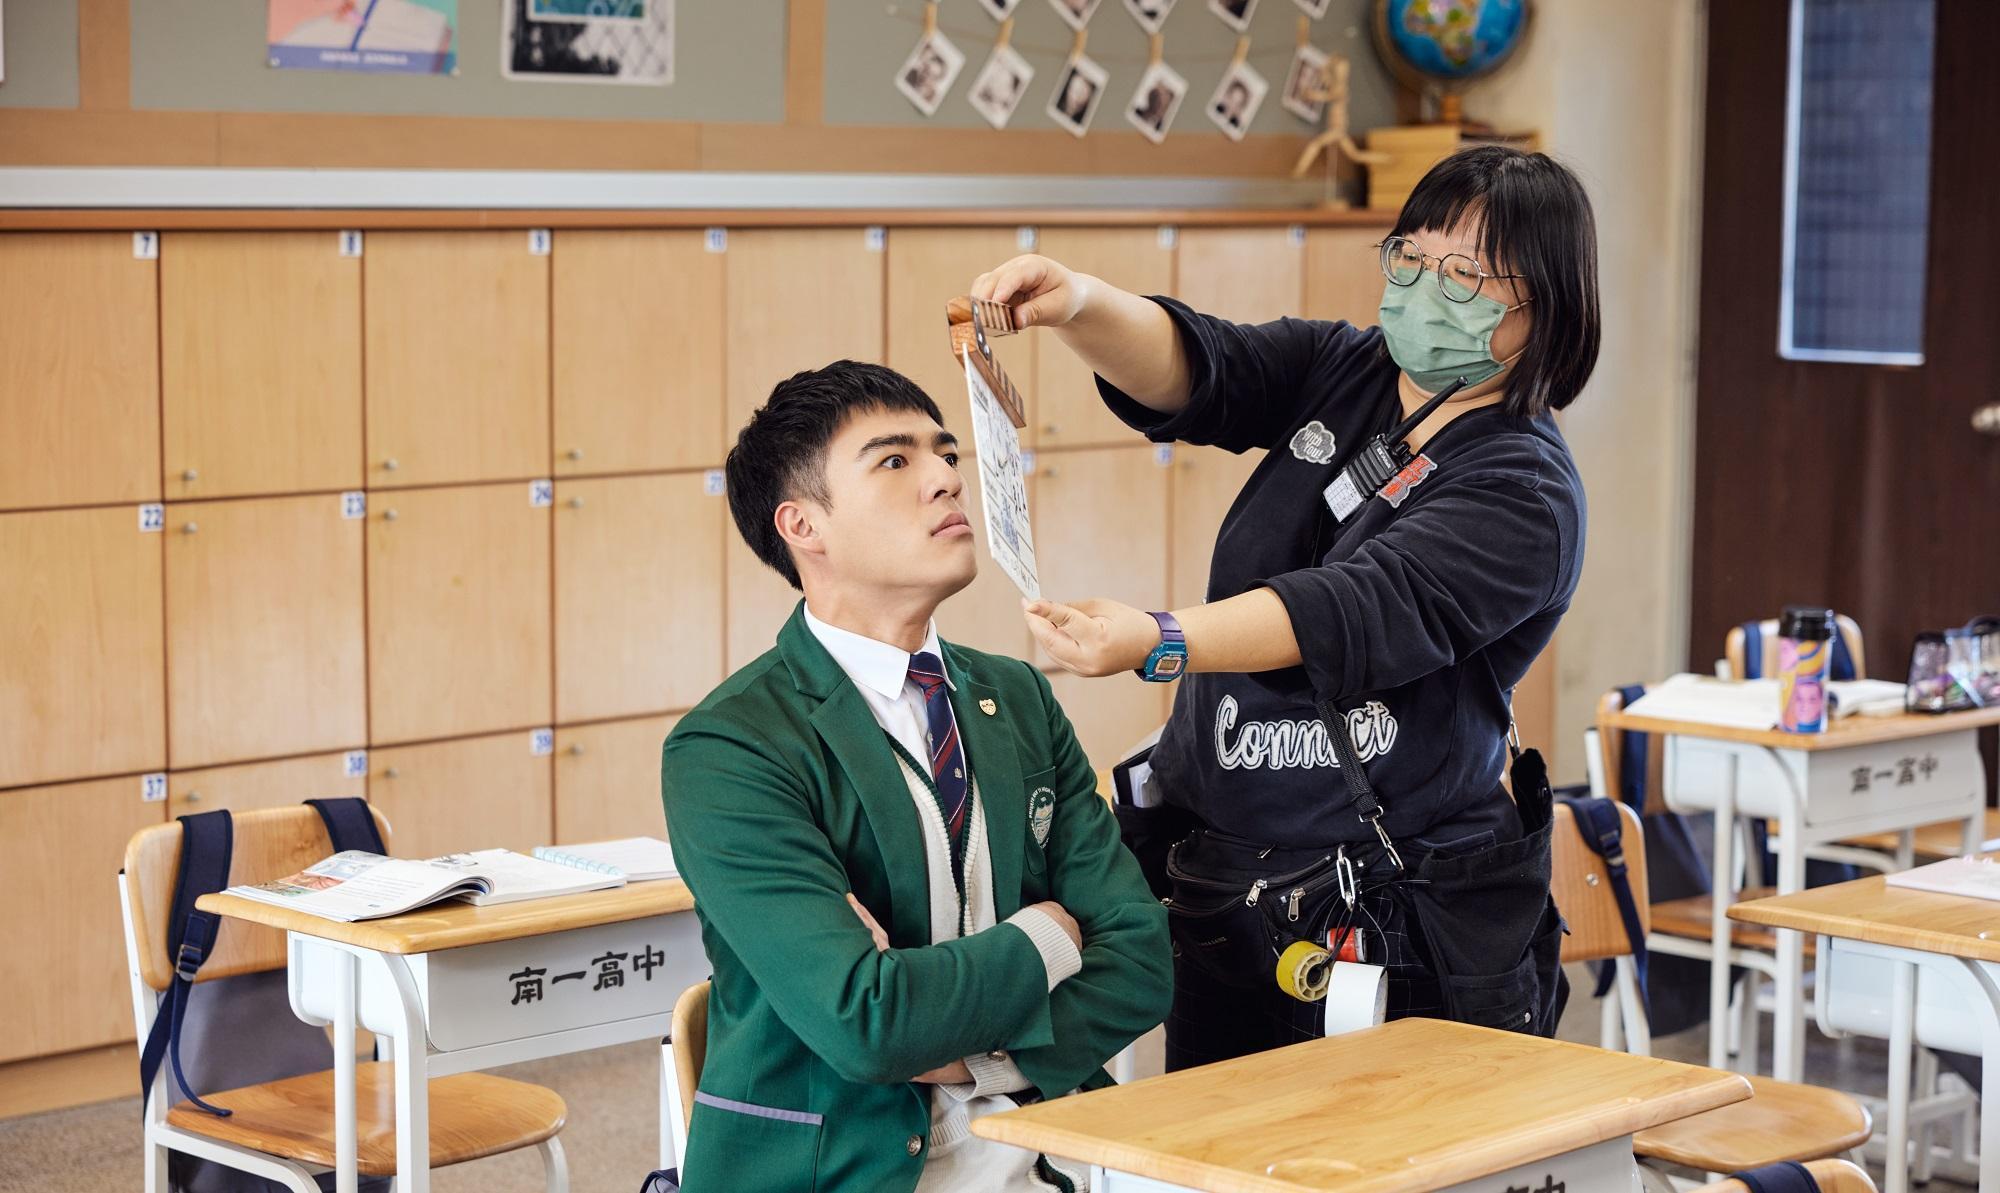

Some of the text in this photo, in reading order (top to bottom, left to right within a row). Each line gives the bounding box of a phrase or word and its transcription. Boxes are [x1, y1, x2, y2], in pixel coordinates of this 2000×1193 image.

[142, 233, 152, 254] 7
[536, 232, 545, 251] 9
[347, 497, 364, 516] 23
[144, 509, 162, 527] 22
[1215, 695, 1398, 770] Connct
[147, 778, 164, 797] 37
[508, 944, 665, 1006] 南一高中
